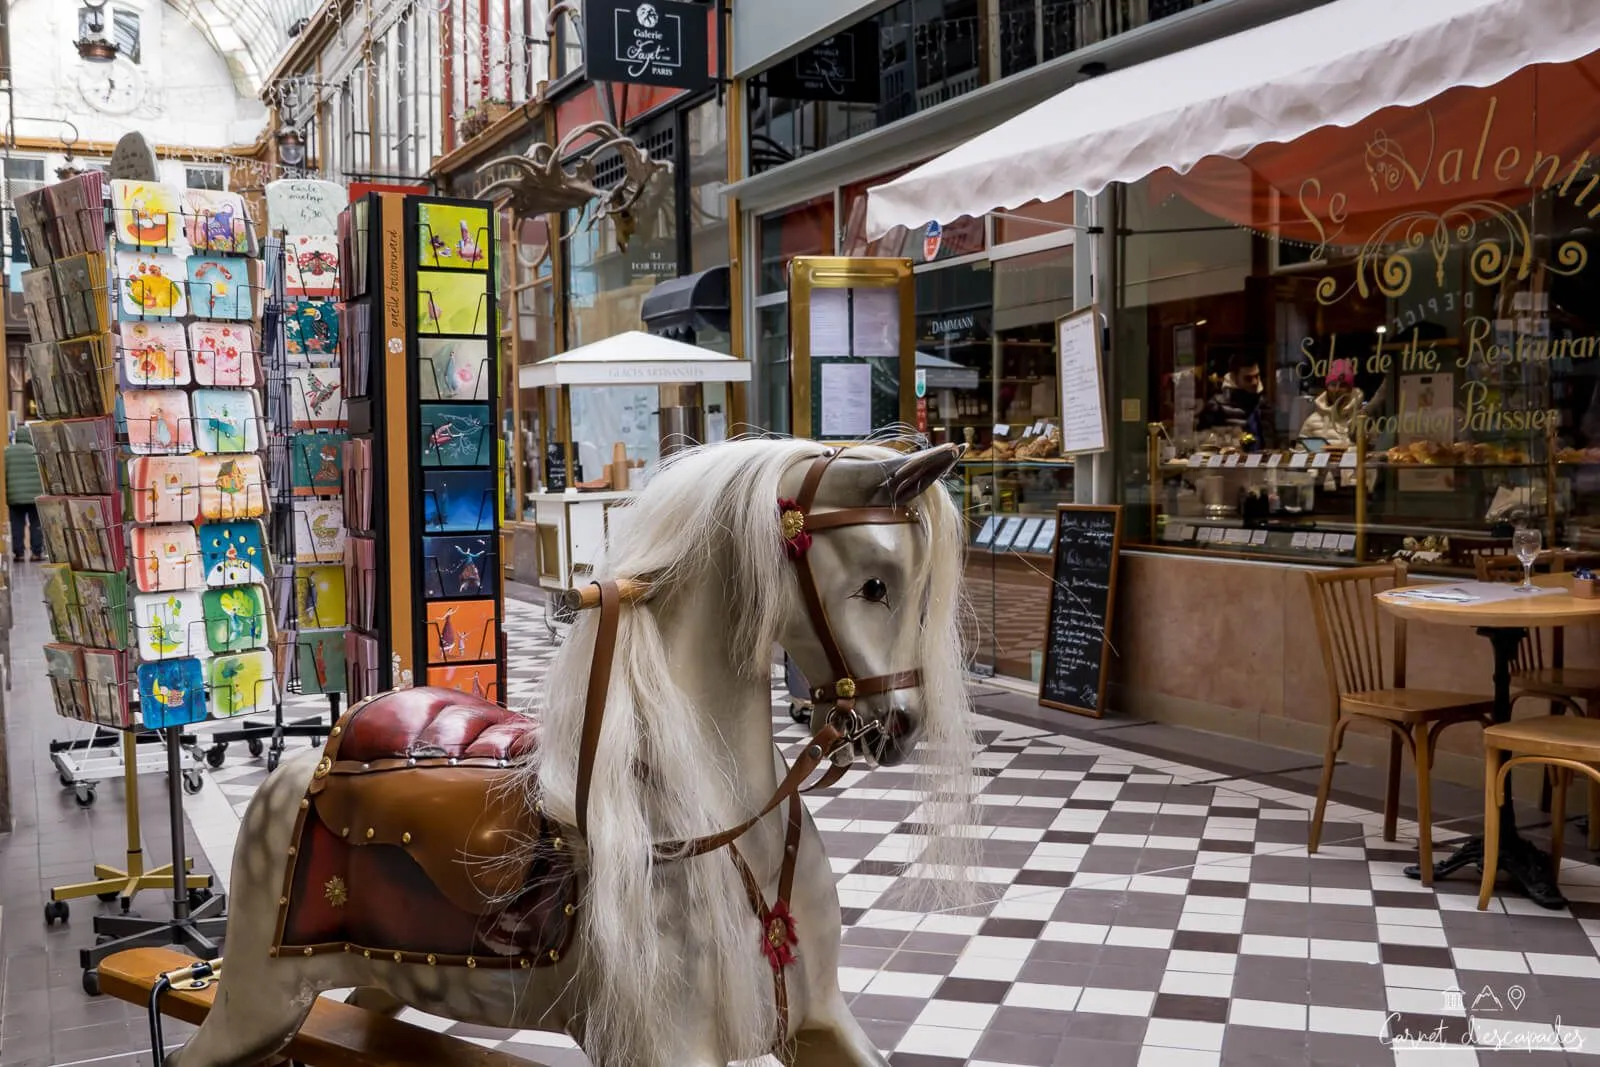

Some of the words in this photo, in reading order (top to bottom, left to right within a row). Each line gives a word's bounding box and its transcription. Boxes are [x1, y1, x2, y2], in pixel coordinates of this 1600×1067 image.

[633, 28, 663, 40] Galerie
[627, 40, 662, 77] Fayet
[651, 67, 673, 76] PARIS
[931, 314, 975, 335] DAMMANN
[1366, 331, 1392, 374] de
